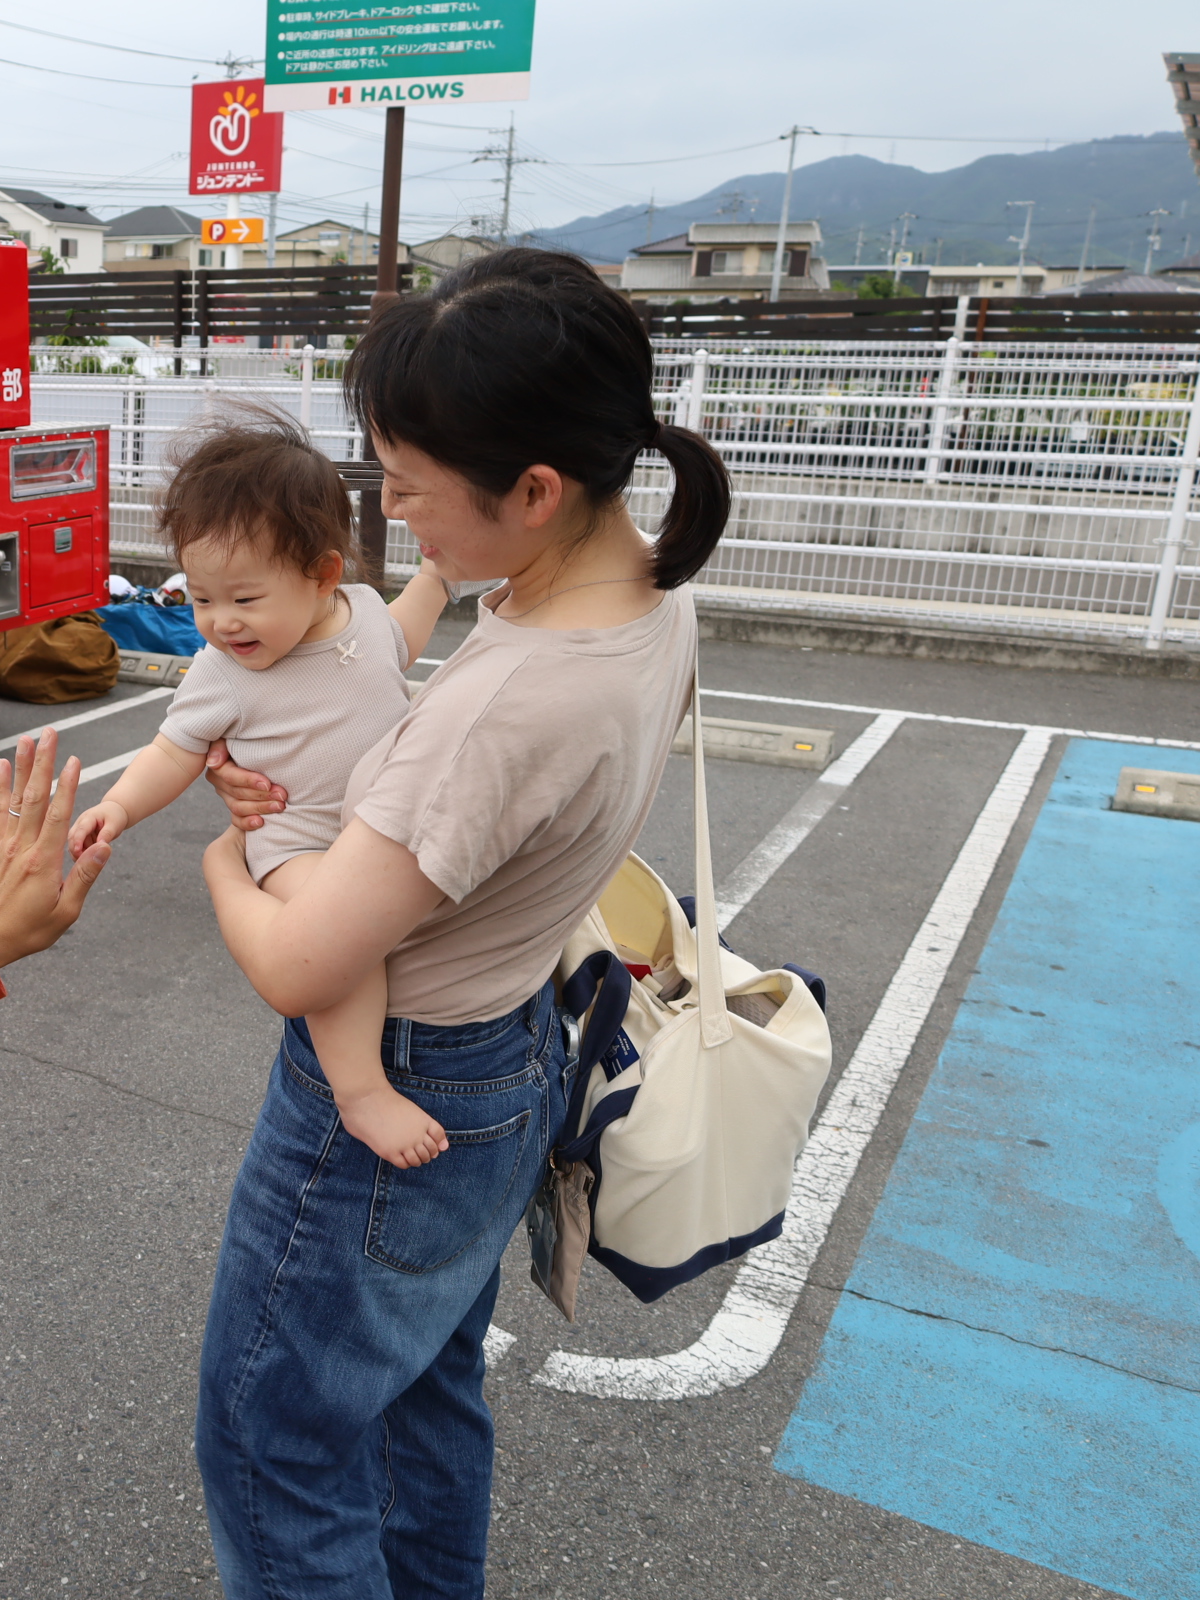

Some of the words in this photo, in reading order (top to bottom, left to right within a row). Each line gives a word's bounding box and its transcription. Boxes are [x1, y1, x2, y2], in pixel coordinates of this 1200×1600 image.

[360, 82, 465, 102] HALOWS
[196, 172, 265, 190] ジュンテンドー
[211, 223, 224, 241] P
